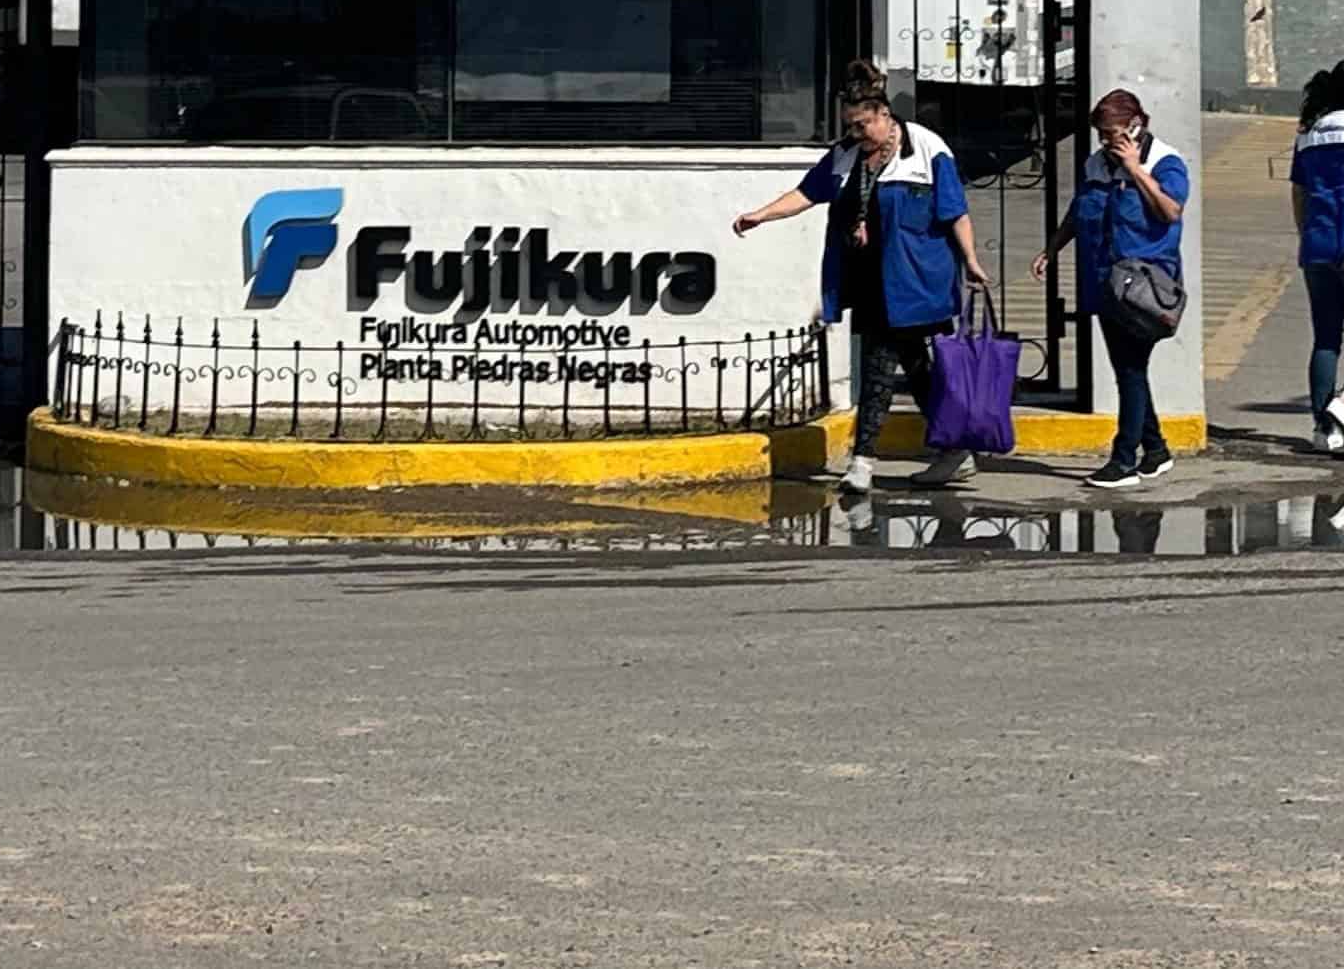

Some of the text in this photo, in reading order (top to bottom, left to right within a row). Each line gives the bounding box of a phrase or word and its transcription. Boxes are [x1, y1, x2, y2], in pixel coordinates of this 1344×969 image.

[355, 225, 716, 313] Fujikura
[359, 316, 630, 349] Fujikura Automotive
[359, 352, 651, 388] Planta Piedras Negras
